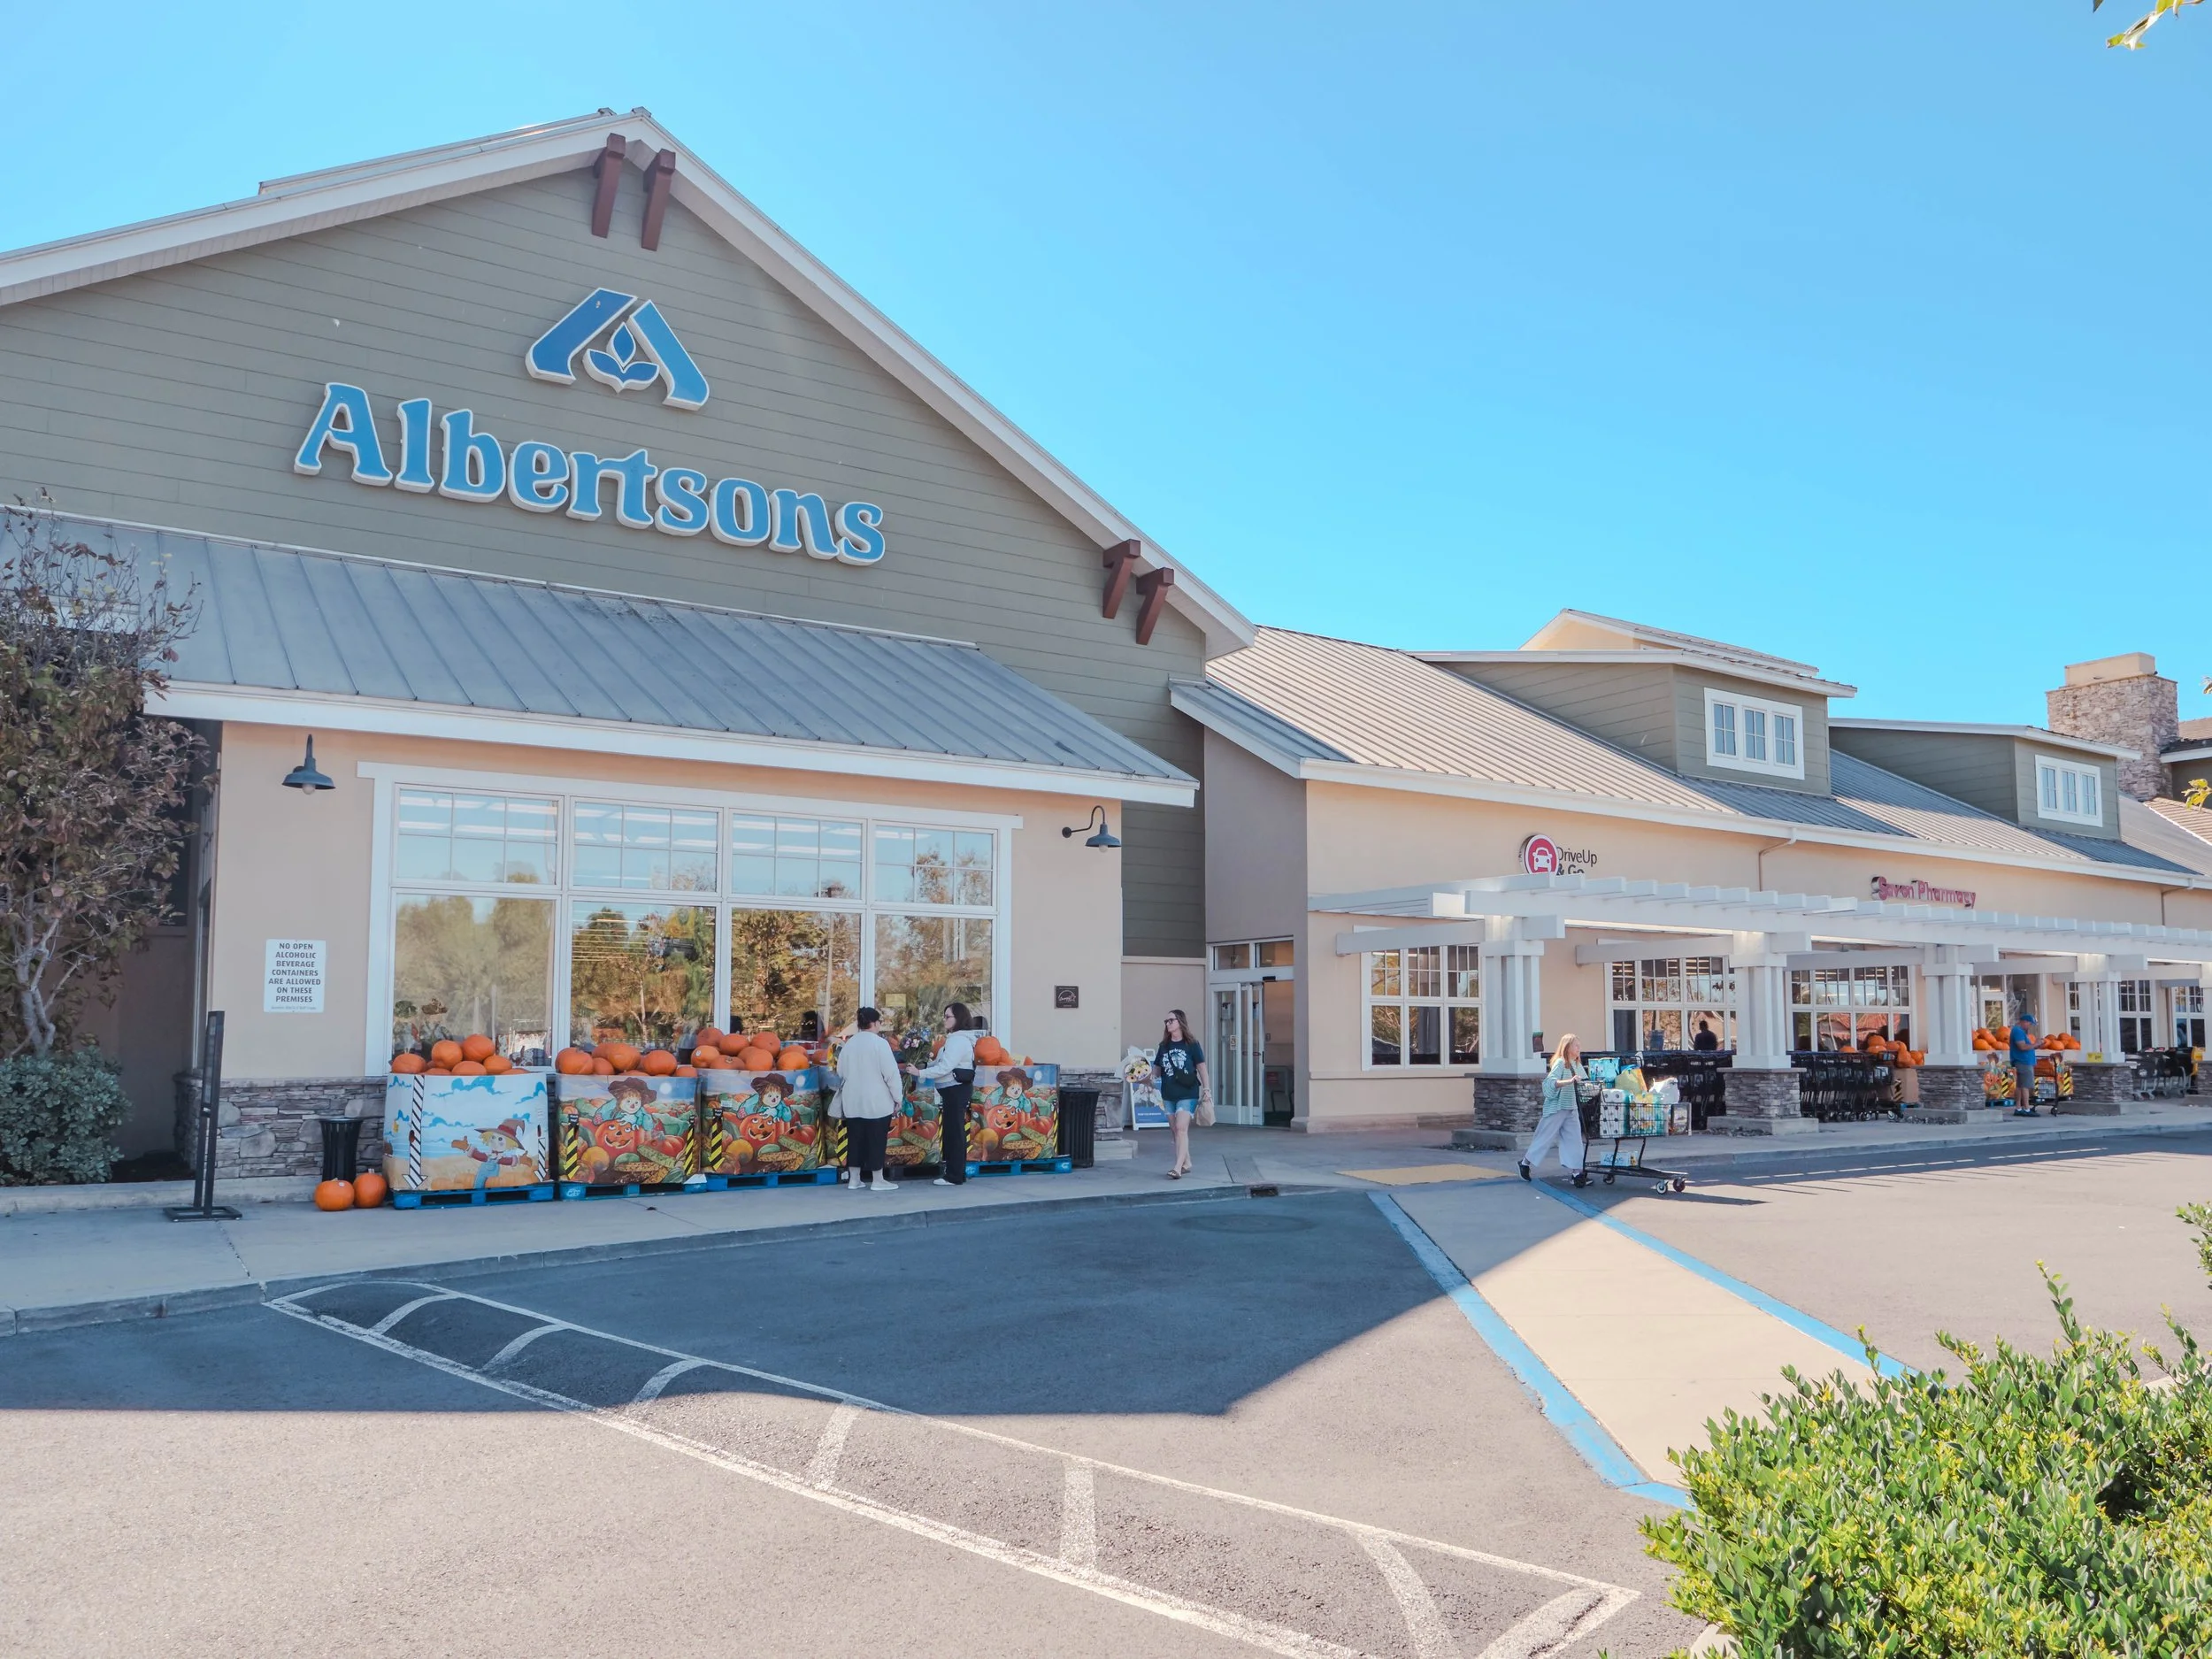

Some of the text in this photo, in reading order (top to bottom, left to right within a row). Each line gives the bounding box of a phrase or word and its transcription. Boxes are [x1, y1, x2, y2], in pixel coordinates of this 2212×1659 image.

[294, 381, 886, 566] Albertsons
[1556, 847, 1598, 867] DriveUp
[1912, 880, 1977, 909] Pharmacy
